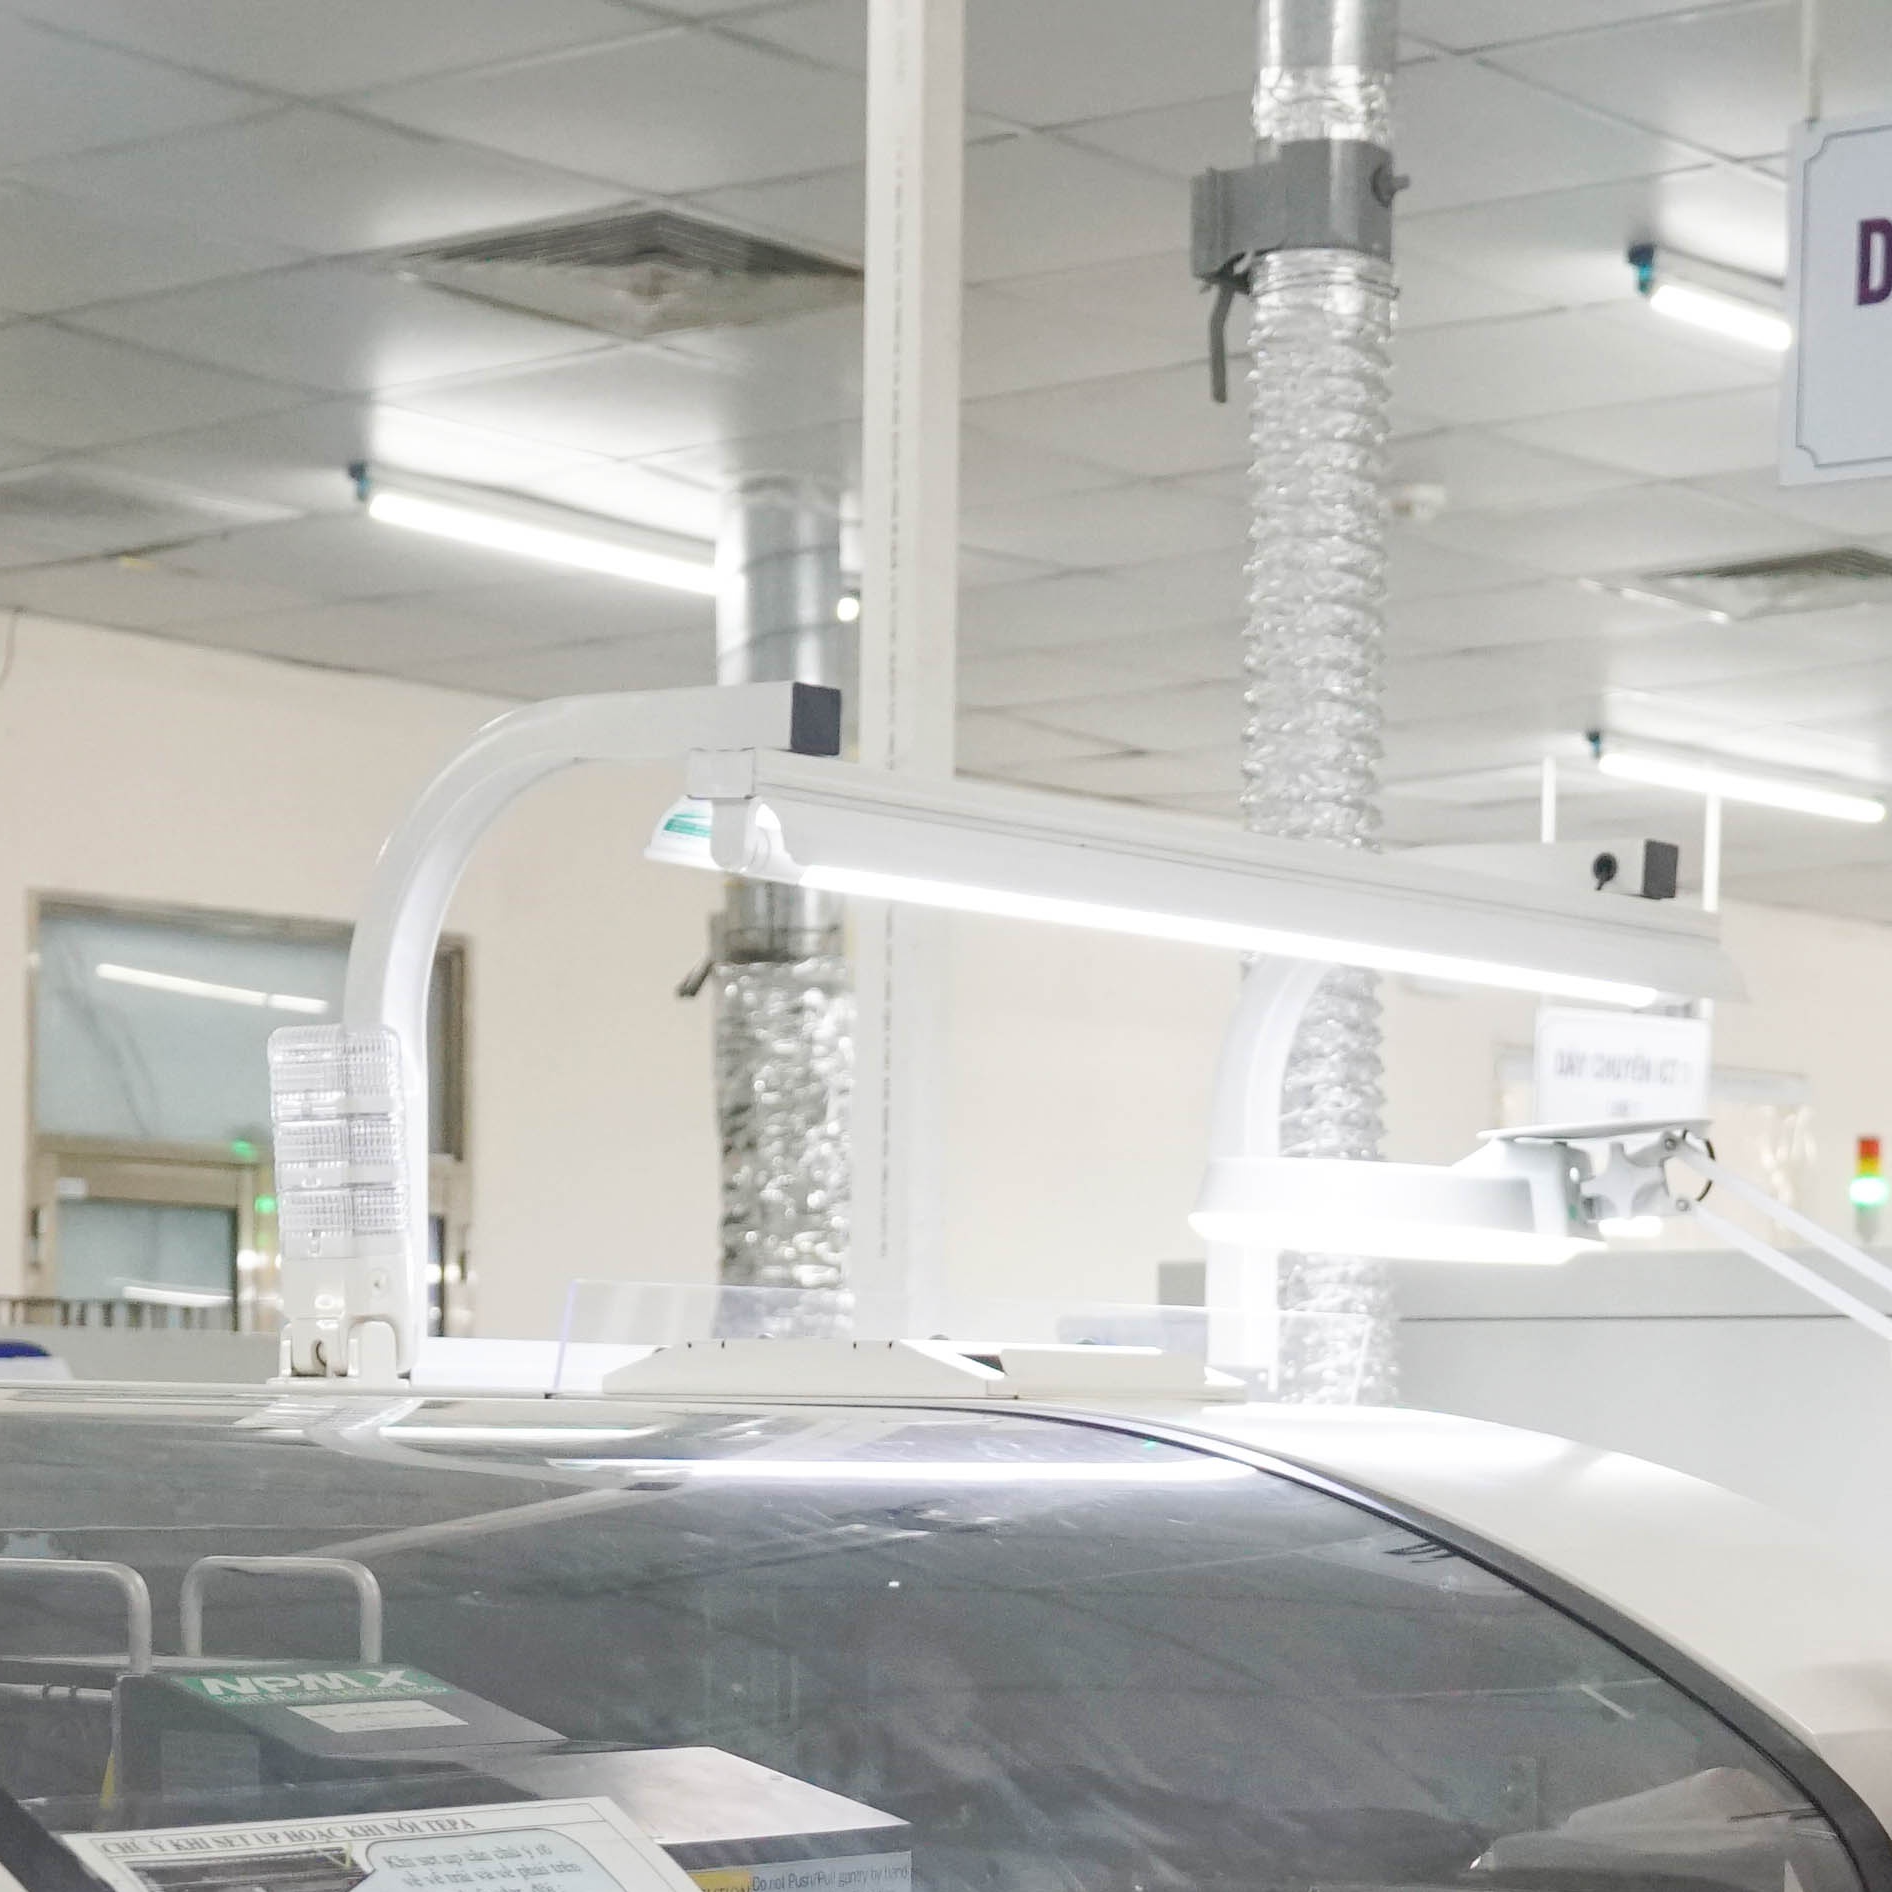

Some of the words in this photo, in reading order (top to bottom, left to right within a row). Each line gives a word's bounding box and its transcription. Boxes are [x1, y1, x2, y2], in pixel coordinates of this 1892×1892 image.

[200, 1672, 365, 1696] NPM
[368, 1670, 419, 1688] X
[169, 1837, 212, 1854] KHI
[214, 1834, 250, 1850] SET
[345, 1822, 386, 1839] KHI
